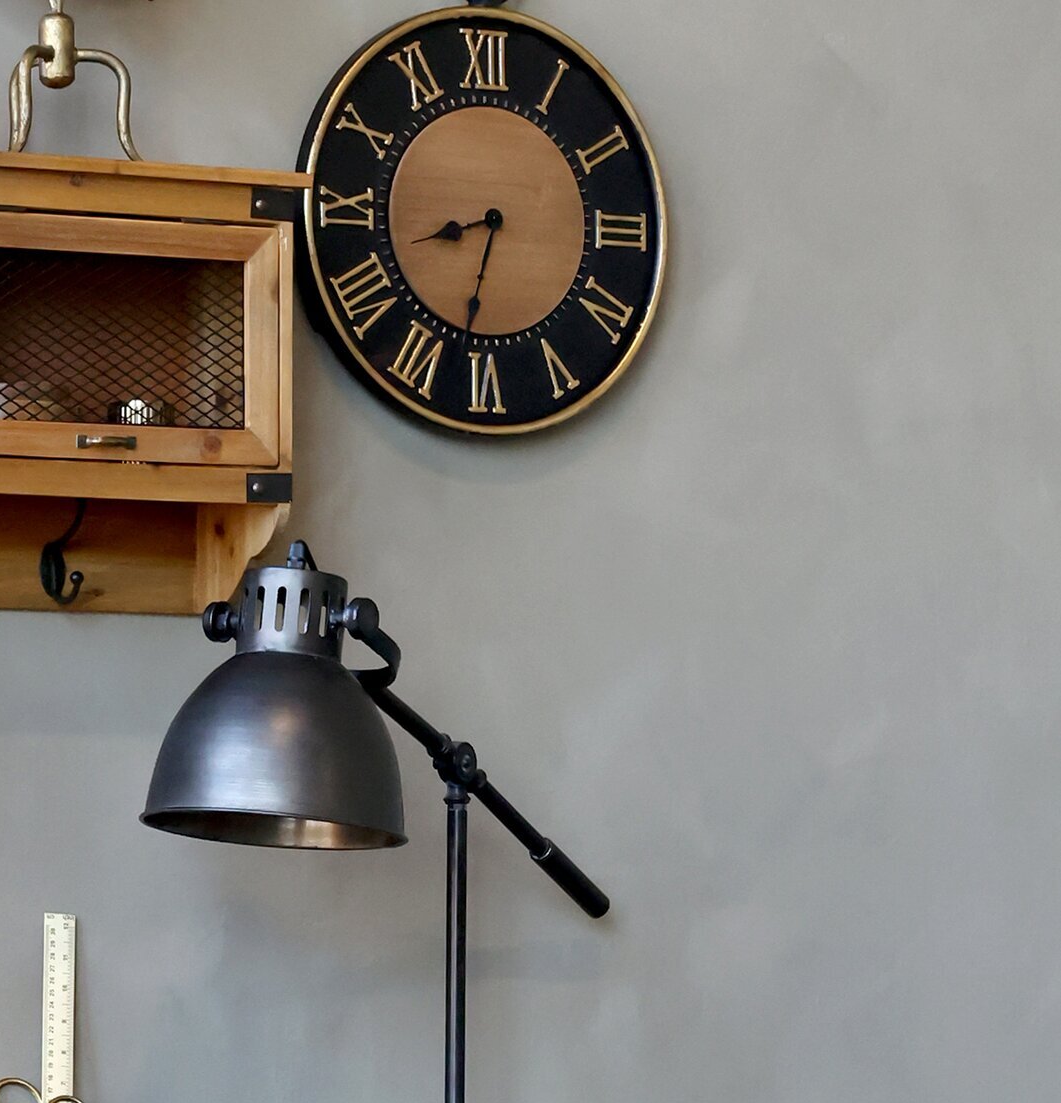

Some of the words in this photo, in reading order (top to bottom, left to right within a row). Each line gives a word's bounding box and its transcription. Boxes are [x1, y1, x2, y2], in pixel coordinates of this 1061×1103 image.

[388, 40, 444, 111] XI
[459, 28, 509, 91] XII
[536, 58, 570, 115] I
[335, 102, 394, 160] X
[575, 124, 629, 175] II
[320, 185, 375, 230] IX
[595, 209, 647, 251] III
[329, 252, 398, 340] VIII
[579, 276, 634, 345] IV
[387, 319, 444, 400] VII
[468, 352, 507, 414] VI
[541, 338, 580, 400] V
